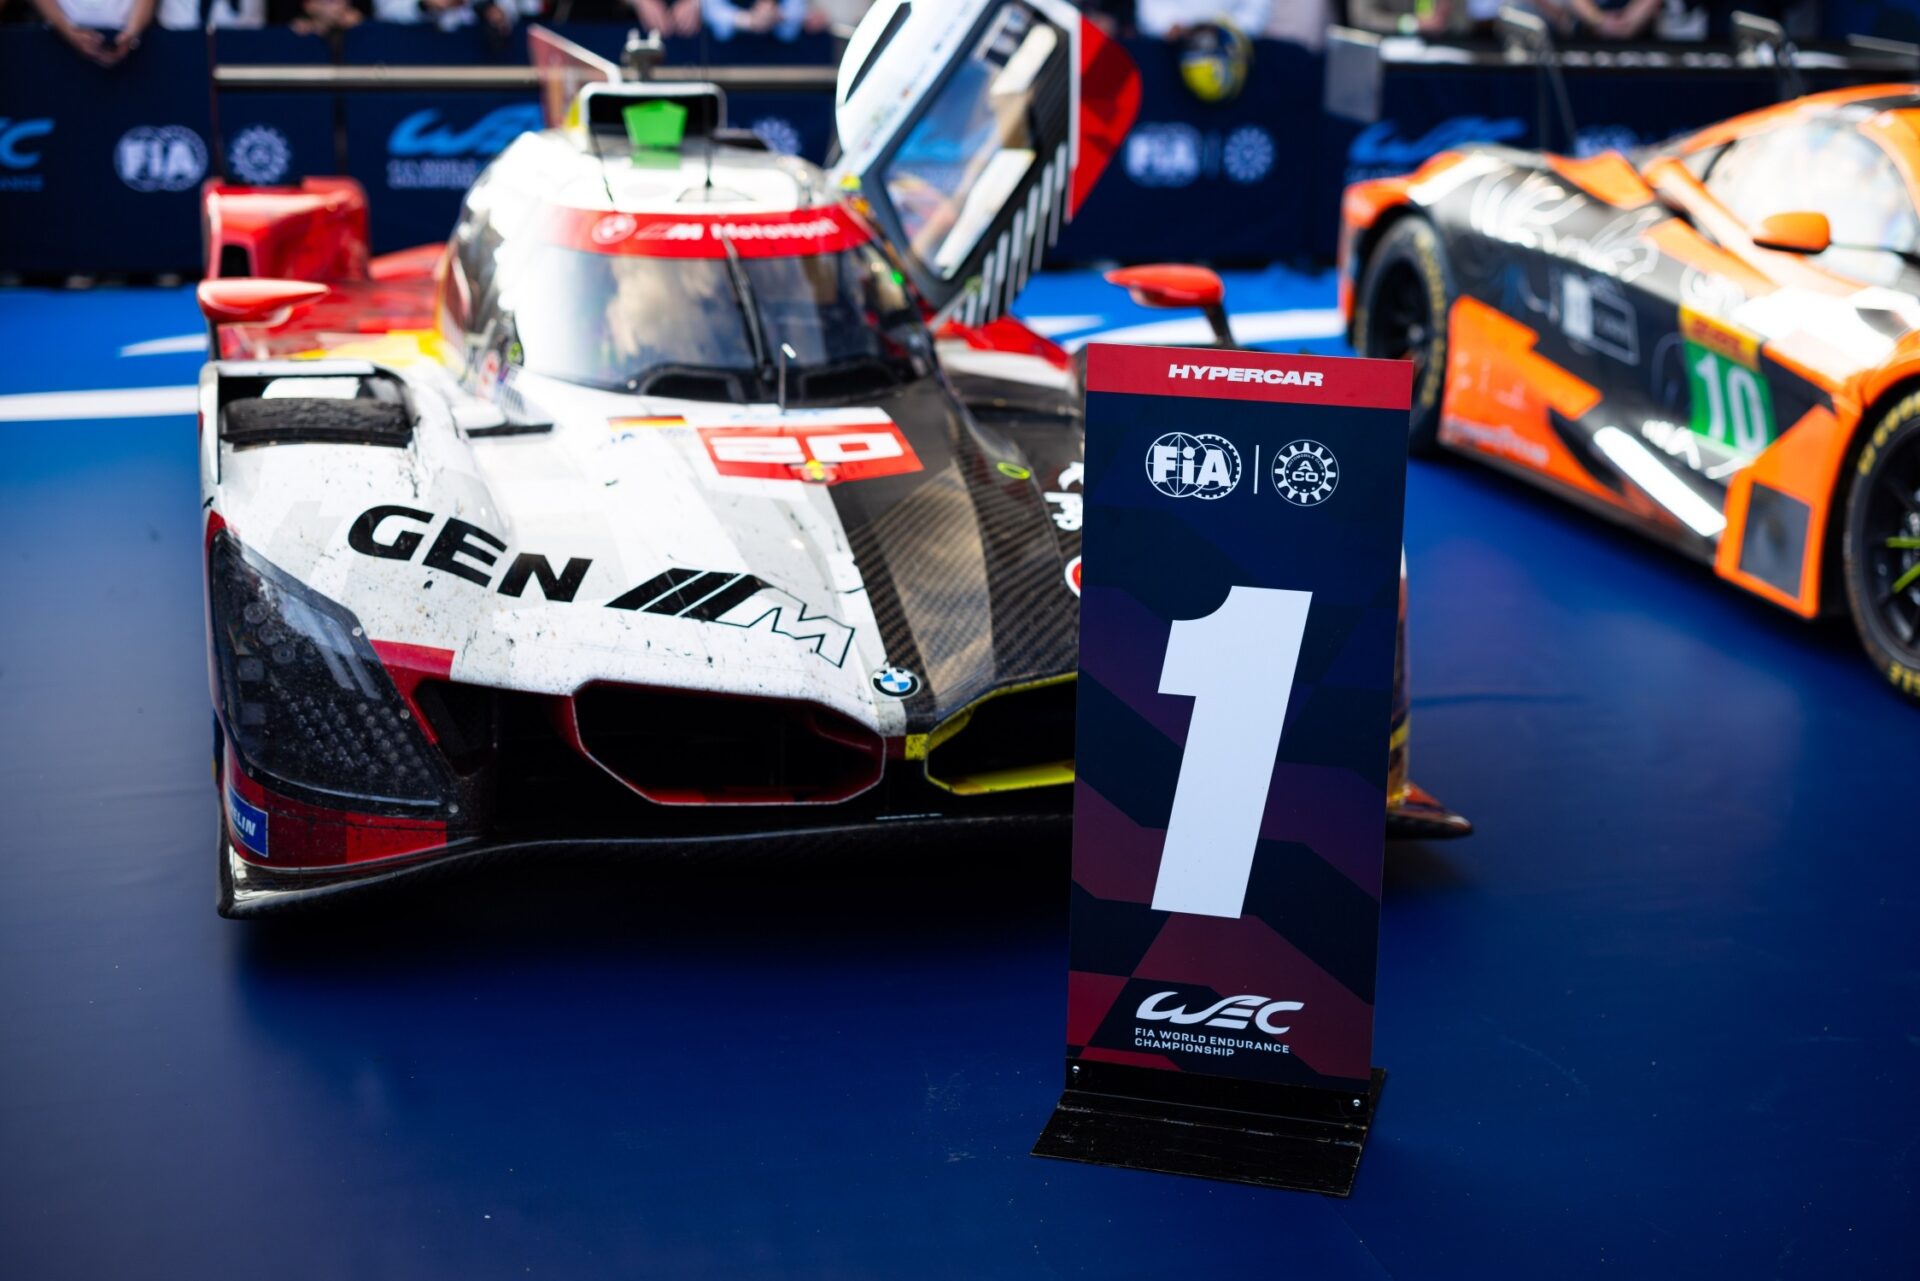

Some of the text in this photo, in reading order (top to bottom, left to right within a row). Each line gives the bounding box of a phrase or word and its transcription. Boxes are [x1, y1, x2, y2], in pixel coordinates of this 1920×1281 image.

[1168, 364, 1324, 387] HYPERCAR
[1695, 351, 1768, 455] 10
[709, 432, 904, 463] 20
[348, 504, 593, 603] GEN
[1151, 585, 1313, 919] 1
[1135, 991, 1305, 1035] WEC
[1134, 1037, 1235, 1057] CHAMPIONSHIP
[1135, 1027, 1290, 1054] FIA WORLD ENDURANCE
